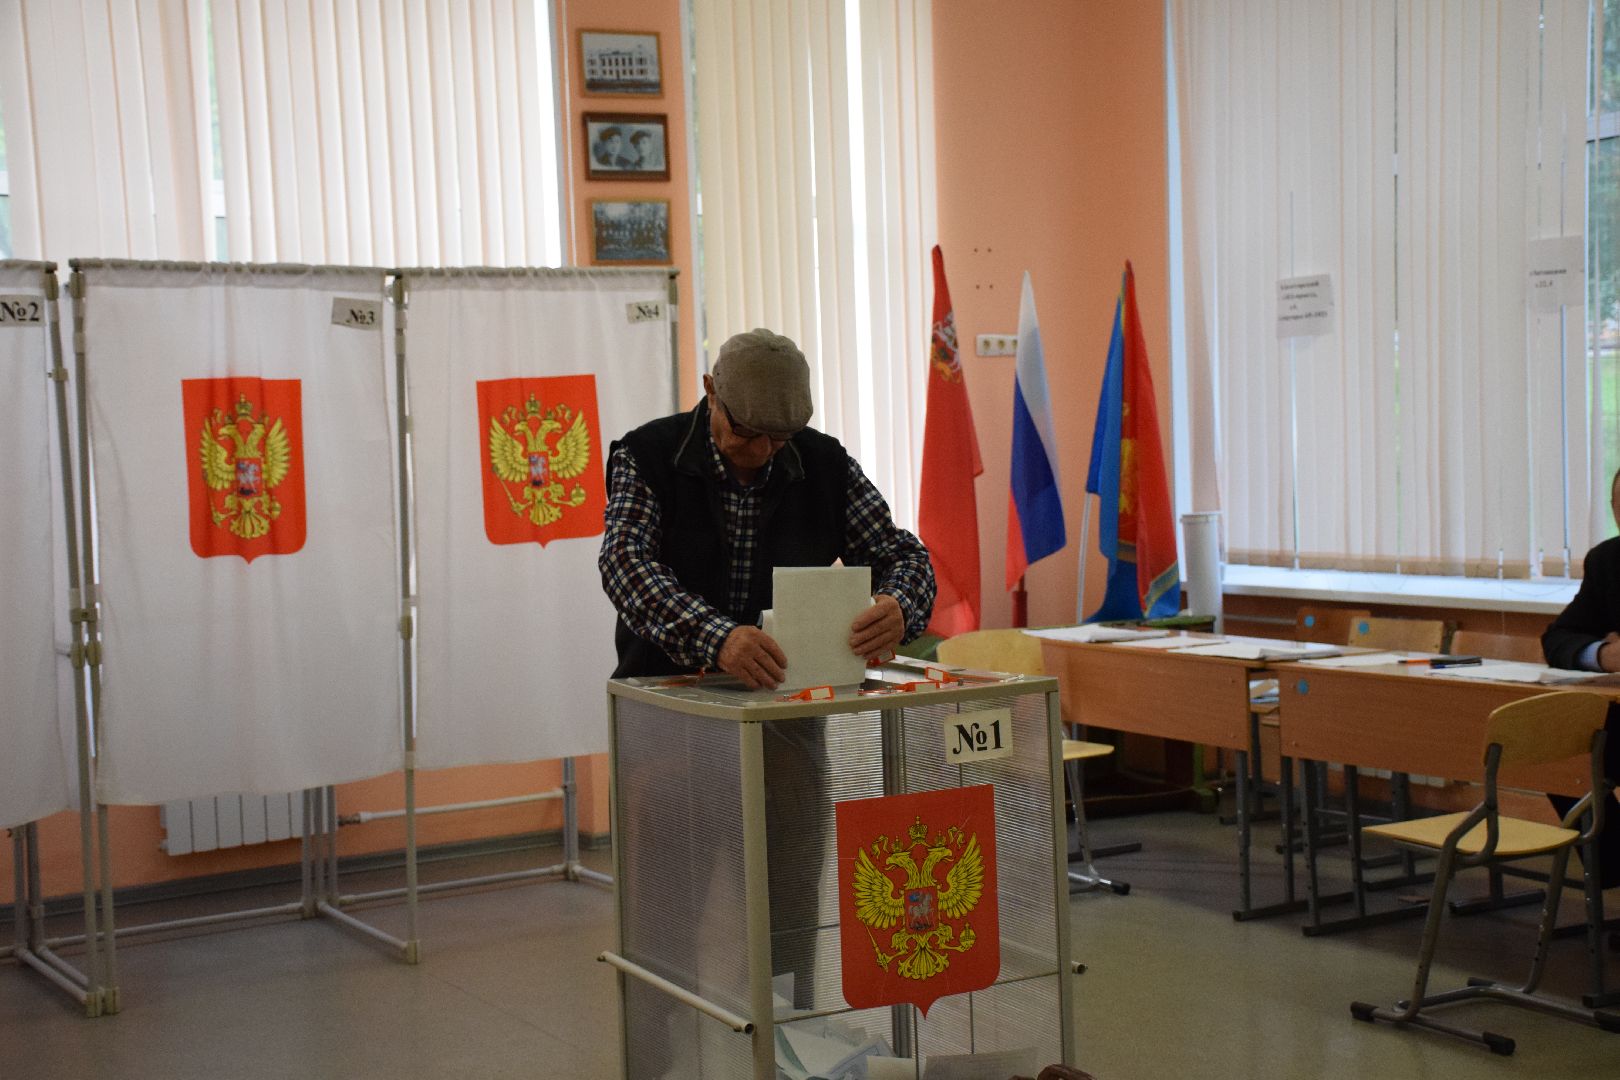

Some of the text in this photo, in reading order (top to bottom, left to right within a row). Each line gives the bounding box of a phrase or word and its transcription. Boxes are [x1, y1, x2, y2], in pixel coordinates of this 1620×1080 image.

[0, 301, 40, 322] №2
[345, 308, 375, 325] №3
[635, 304, 660, 320] №4
[952, 719, 1005, 755] №1
